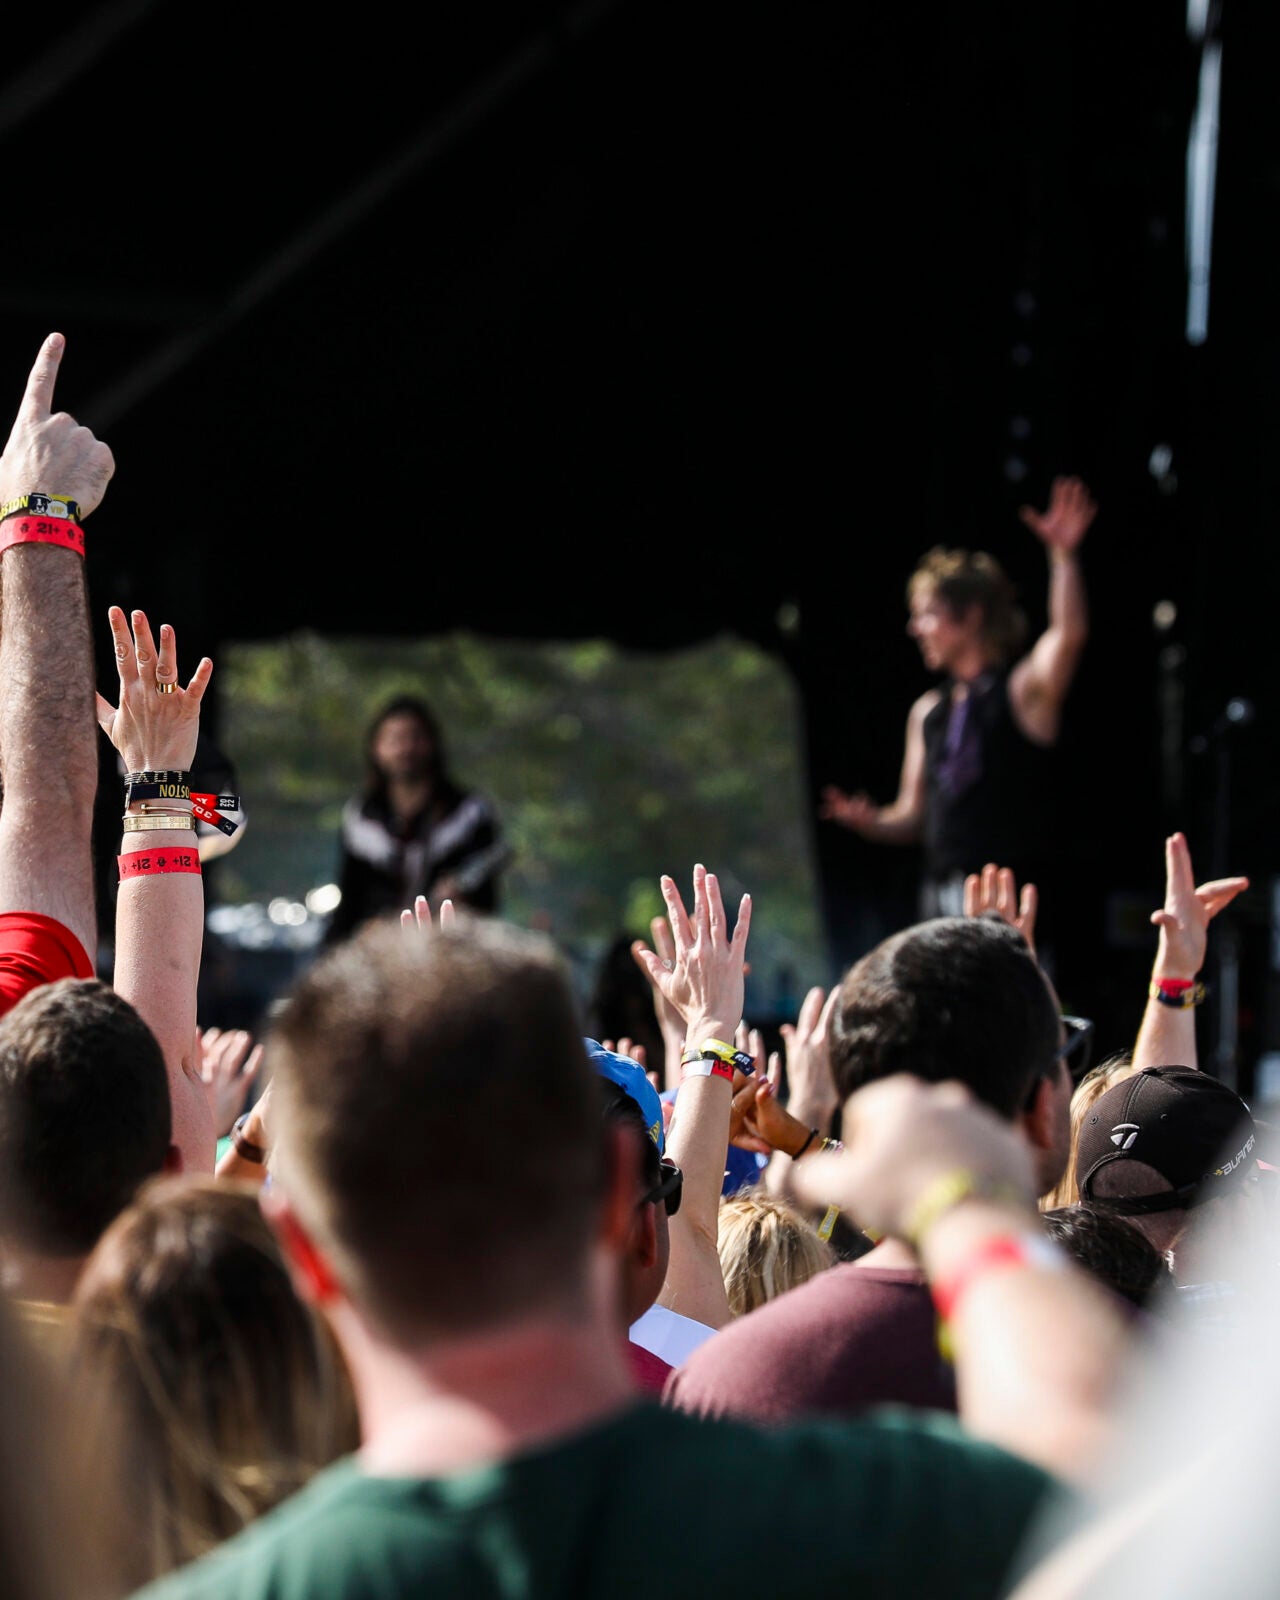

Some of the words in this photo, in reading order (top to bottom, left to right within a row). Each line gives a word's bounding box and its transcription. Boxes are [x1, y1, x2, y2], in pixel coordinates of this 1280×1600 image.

[51, 506, 64, 514] VIP
[37, 522, 61, 535] 21+
[131, 858, 151, 871] 21+
[173, 855, 191, 867] 21+
